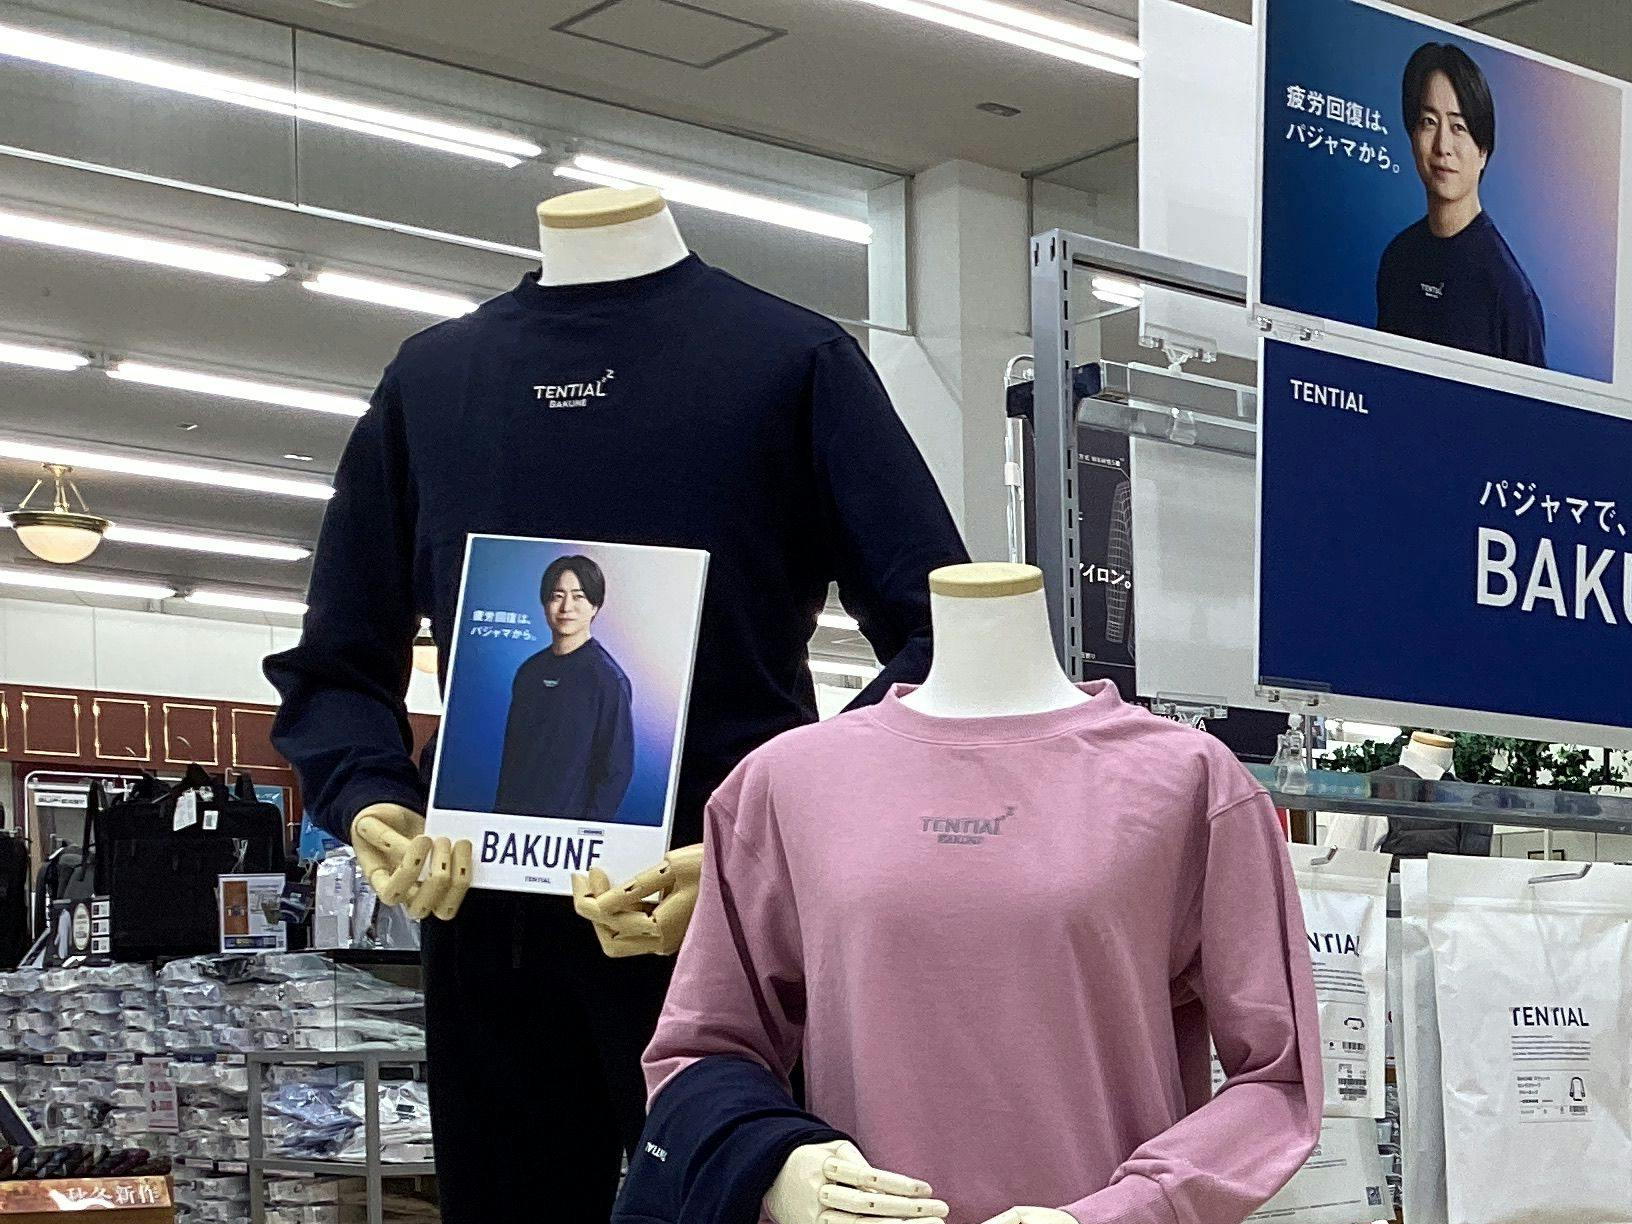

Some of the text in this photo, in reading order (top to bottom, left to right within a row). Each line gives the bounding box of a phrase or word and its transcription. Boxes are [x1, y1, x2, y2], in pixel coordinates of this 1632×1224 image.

[1286, 85, 1389, 136] 疲労回復は、
[1286, 122, 1401, 174] パジャマから。
[533, 380, 606, 400] TENTIAL
[1290, 379, 1369, 414] TENTIAL
[481, 831, 603, 872] BAKUNE
[1306, 932, 1360, 957] NTIAL
[1511, 1006, 1589, 1027] TENTIAL
